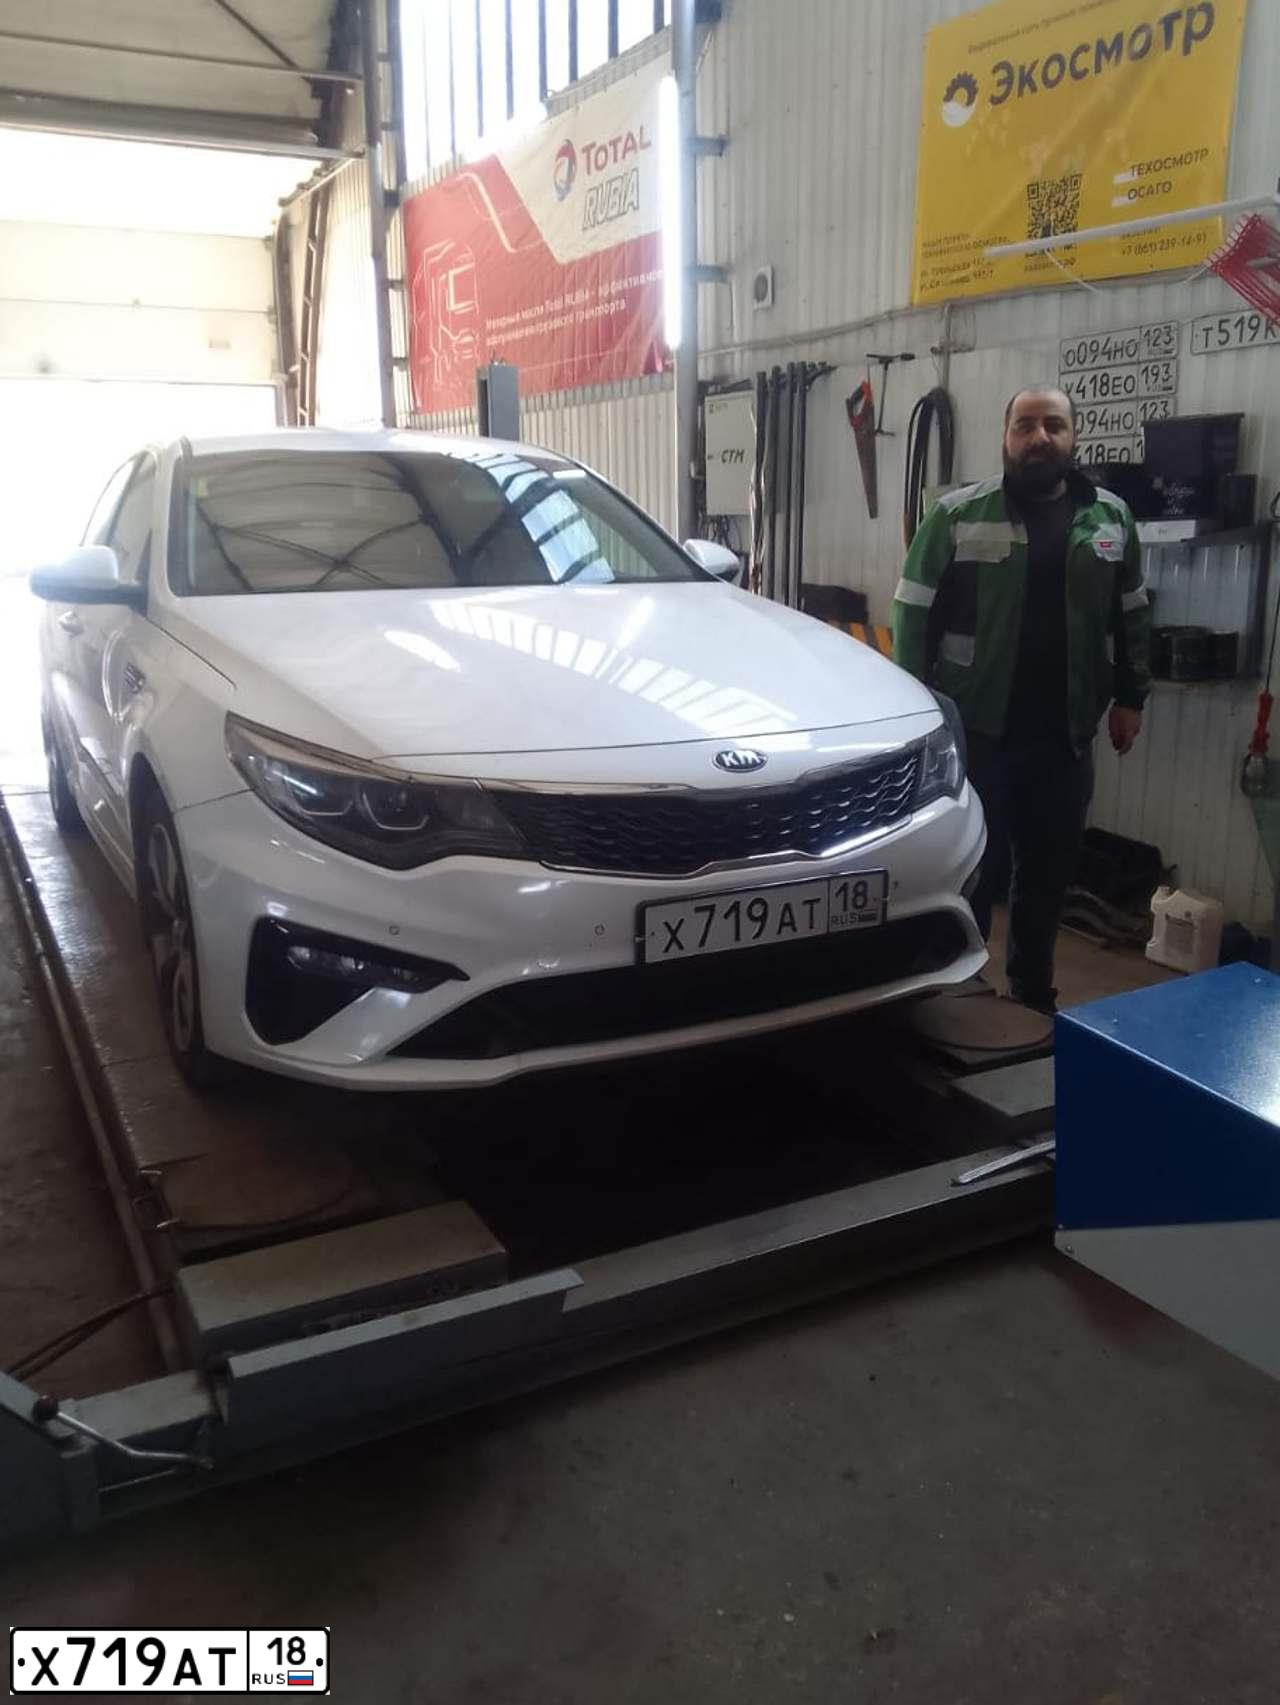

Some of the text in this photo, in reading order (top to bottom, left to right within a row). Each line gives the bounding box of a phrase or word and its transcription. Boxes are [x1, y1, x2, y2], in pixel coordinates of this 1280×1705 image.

[989, 2, 1215, 106] Экосмотр
[581, 124, 652, 175] TOTAL
[1130, 148, 1209, 177] ТЕХОСМОТР
[581, 166, 640, 231] RUBIA
[1127, 181, 1173, 201] ОСАГО
[1143, 325, 1174, 348] 123
[1202, 314, 1277, 349] Т519К
[1141, 362, 1172, 385] 193
[721, 749, 762, 767] KIA
[663, 880, 868, 953] Х719АТ 18
[831, 912, 857, 925] RUS
